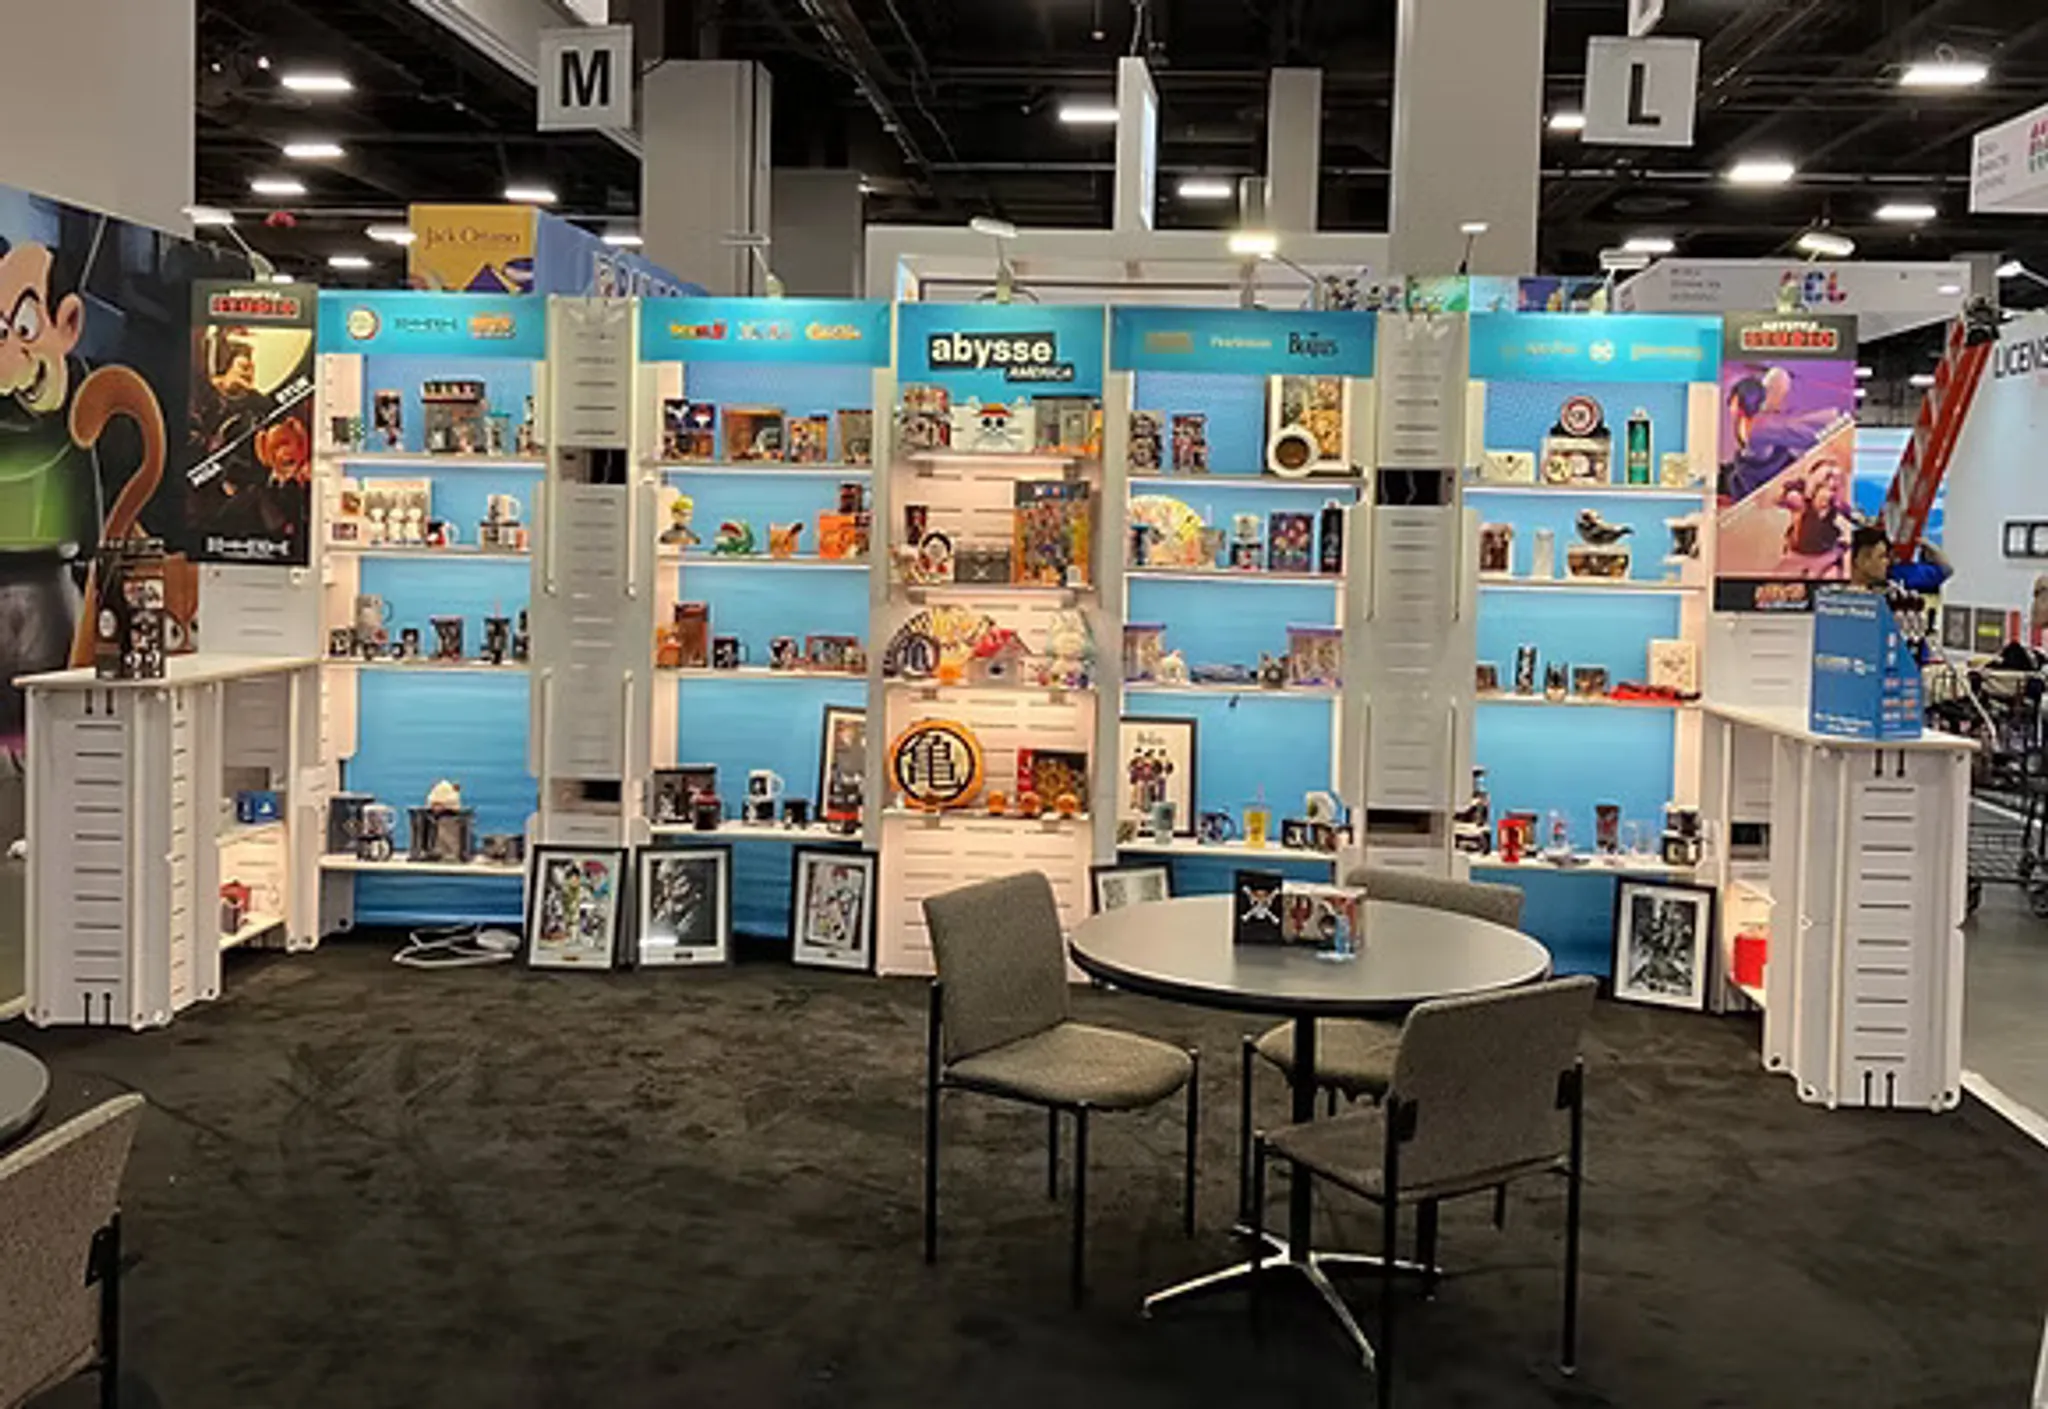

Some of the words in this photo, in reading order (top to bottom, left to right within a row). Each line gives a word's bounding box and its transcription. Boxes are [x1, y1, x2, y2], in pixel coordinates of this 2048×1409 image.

[562, 51, 610, 107] M
[1628, 63, 1661, 125] L
[932, 332, 1053, 369] abysse
